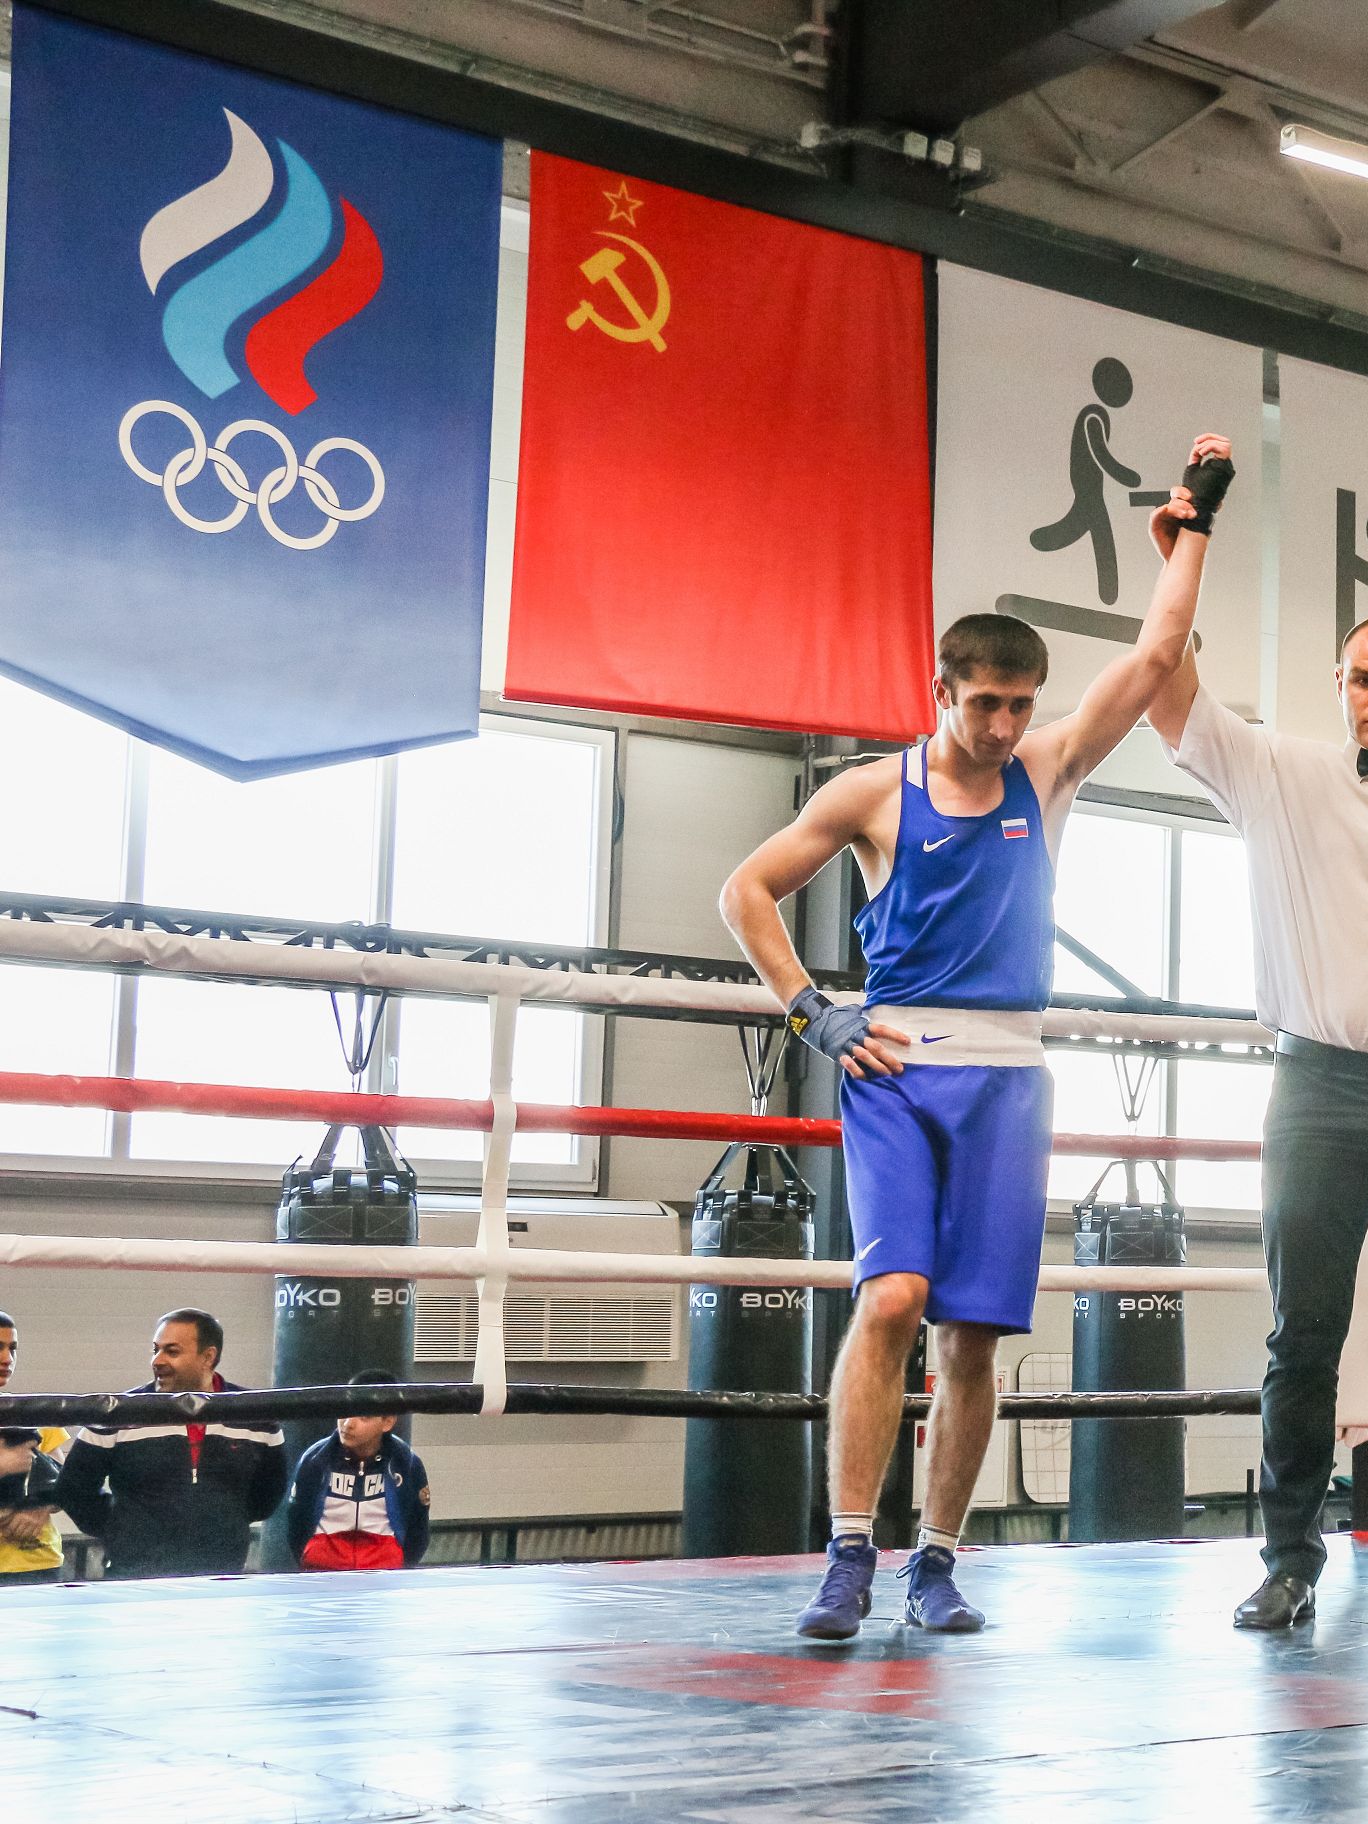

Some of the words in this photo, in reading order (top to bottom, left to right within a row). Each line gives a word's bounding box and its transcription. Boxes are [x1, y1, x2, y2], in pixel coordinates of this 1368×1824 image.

[275, 1283, 341, 1307] OYKO
[371, 1283, 416, 1306] BOY
[1118, 1295, 1184, 1312] BOYKO
